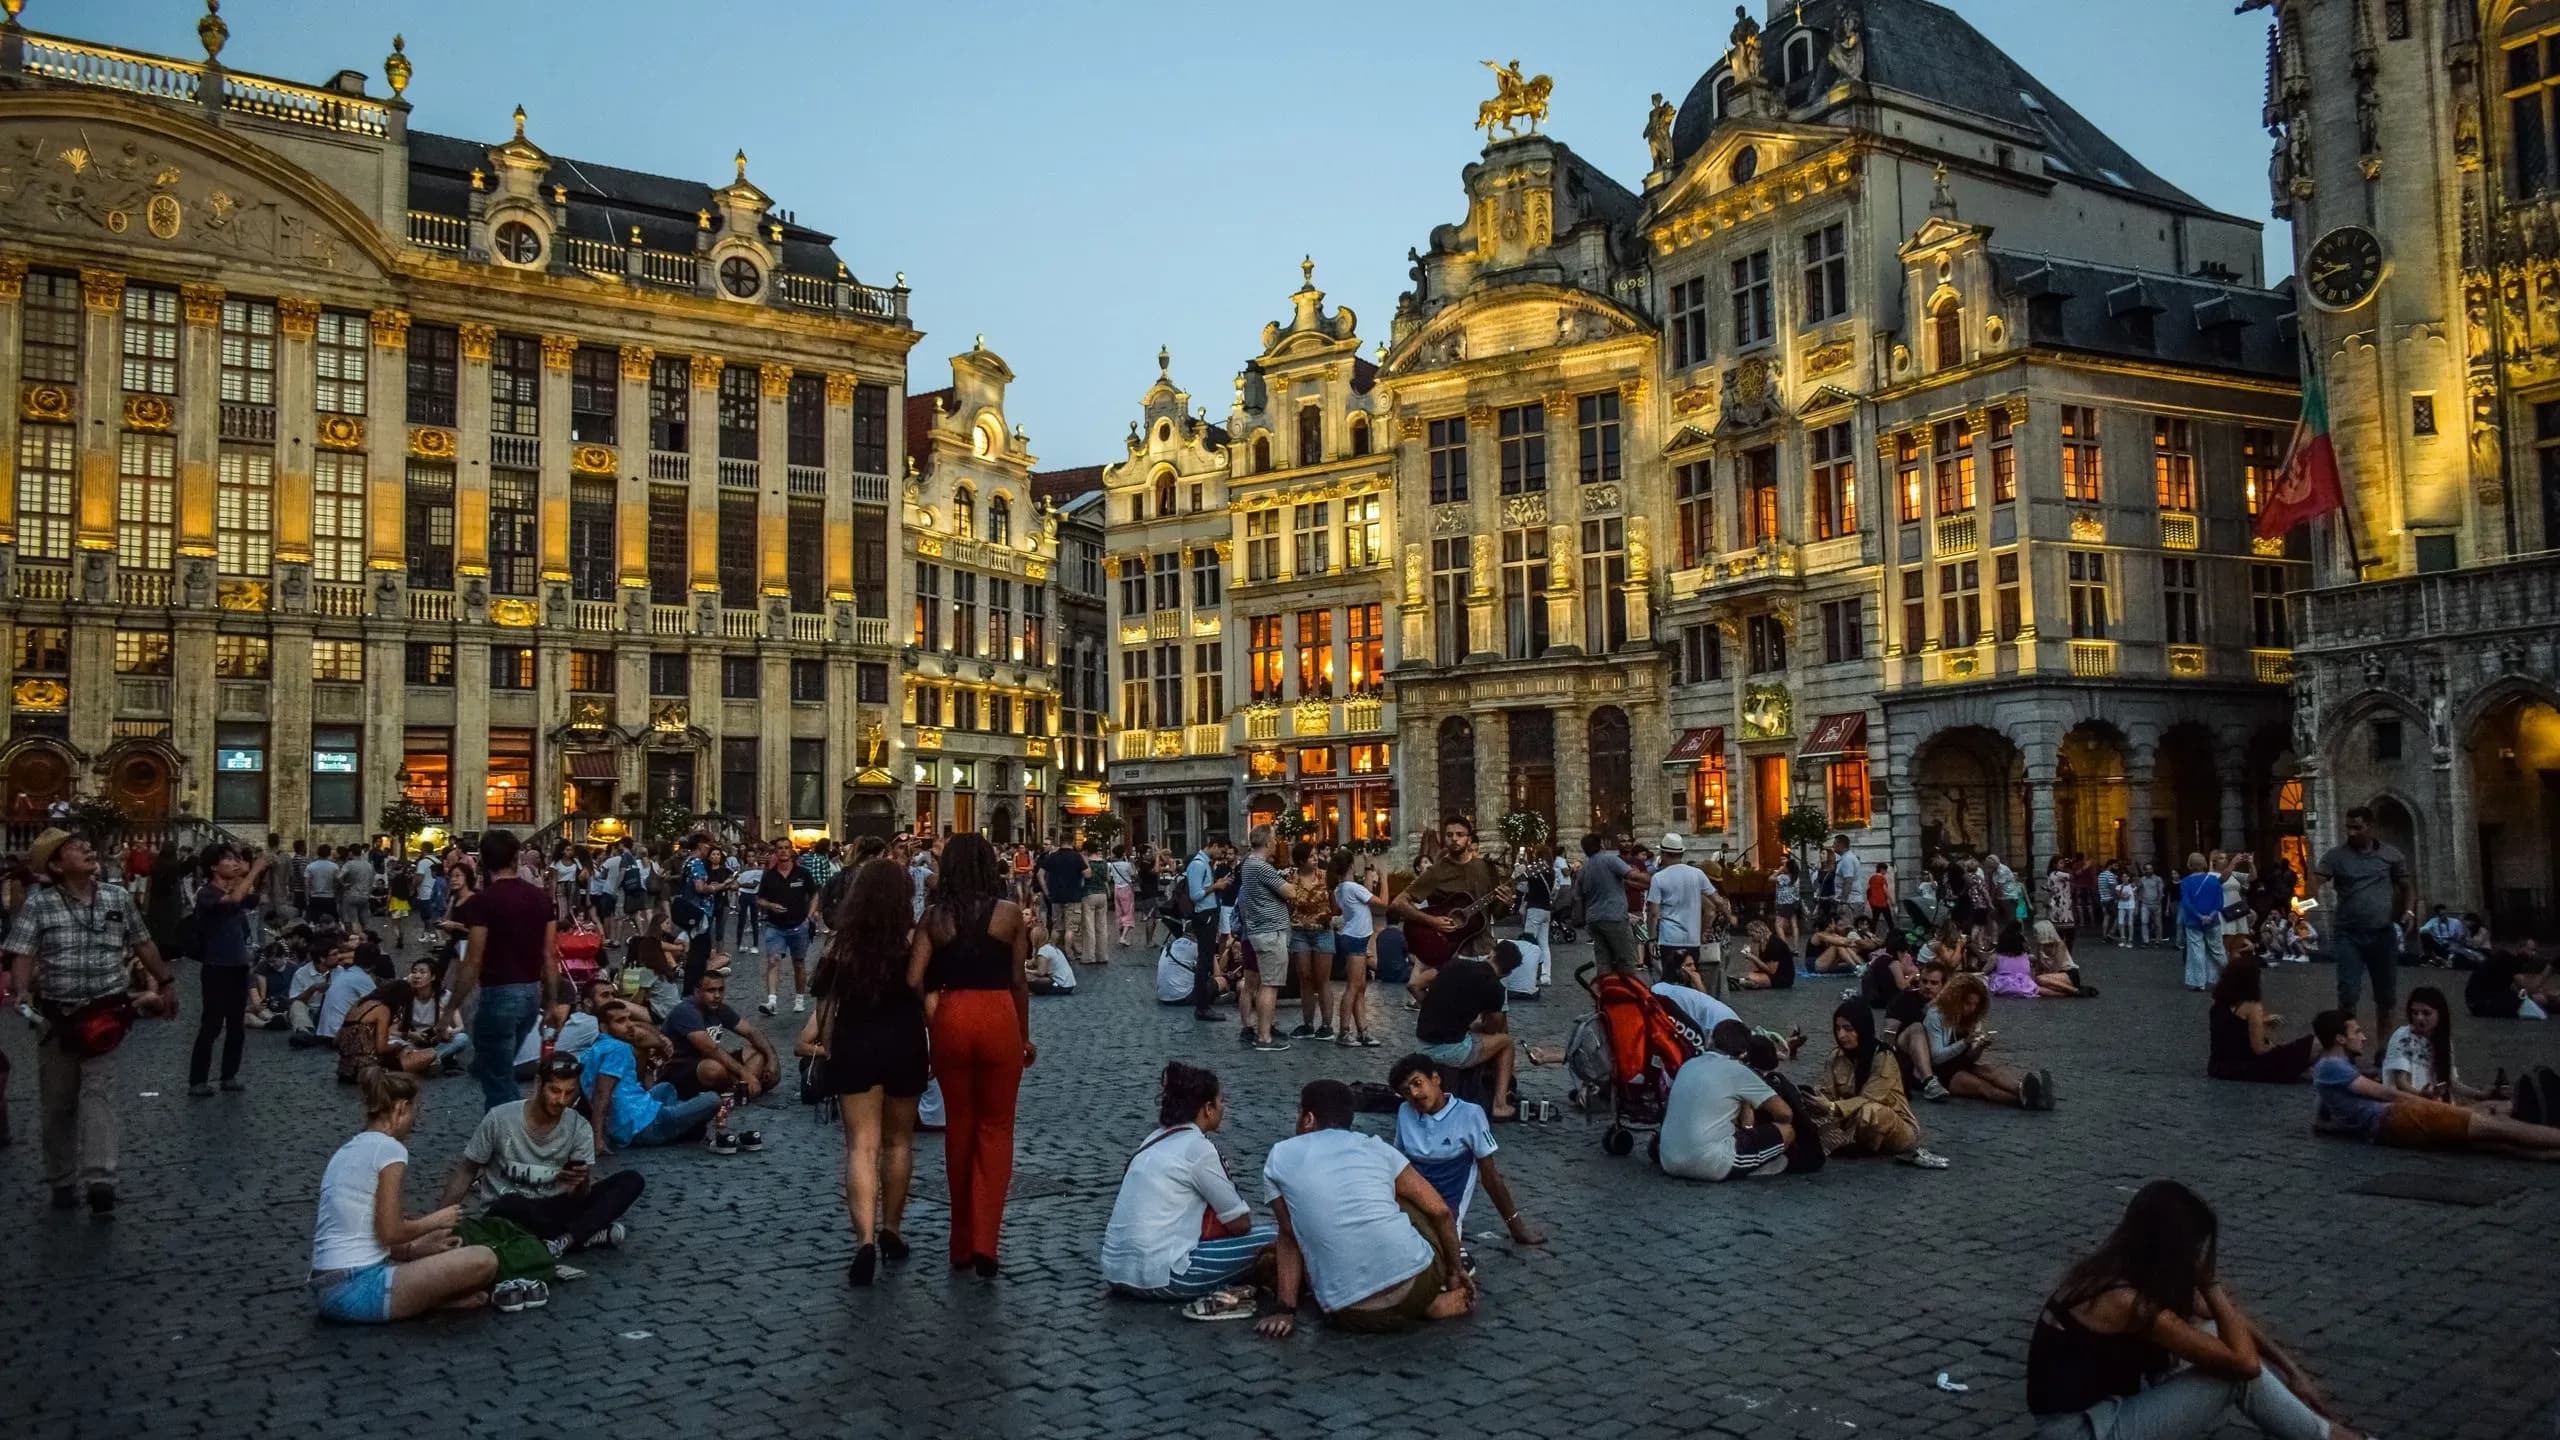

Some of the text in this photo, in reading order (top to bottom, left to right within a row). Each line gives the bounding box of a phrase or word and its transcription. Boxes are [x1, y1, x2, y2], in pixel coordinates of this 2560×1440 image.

[1614, 276, 1646, 291] 1698
[318, 753, 347, 762] Private
[318, 762, 351, 771] Banking
